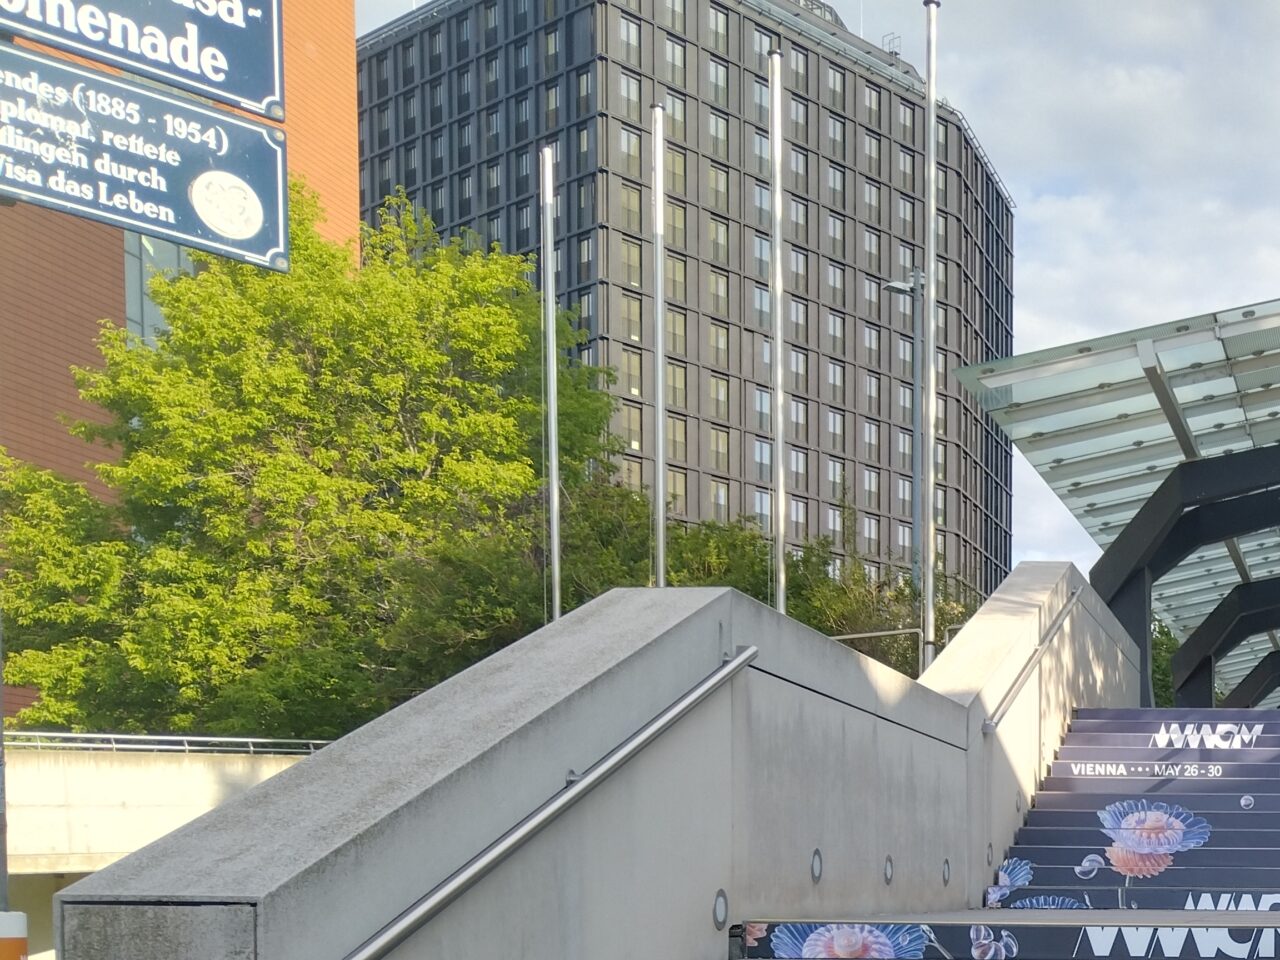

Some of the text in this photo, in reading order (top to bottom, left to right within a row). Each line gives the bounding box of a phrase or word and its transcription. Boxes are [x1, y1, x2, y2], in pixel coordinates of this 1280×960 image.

[0, 70, 68, 106] ndes
[72, 83, 140, 125] (1885
[163, 113, 229, 156] 1954)
[102, 130, 182, 167] rettete
[95, 152, 167, 192] durch
[48, 169, 94, 200] das
[98, 181, 176, 224] Leben
[1071, 763, 1127, 776] VIENNA
[1154, 764, 1181, 776] MAY
[1183, 764, 1199, 777] 26
[1207, 765, 1222, 777] 30
